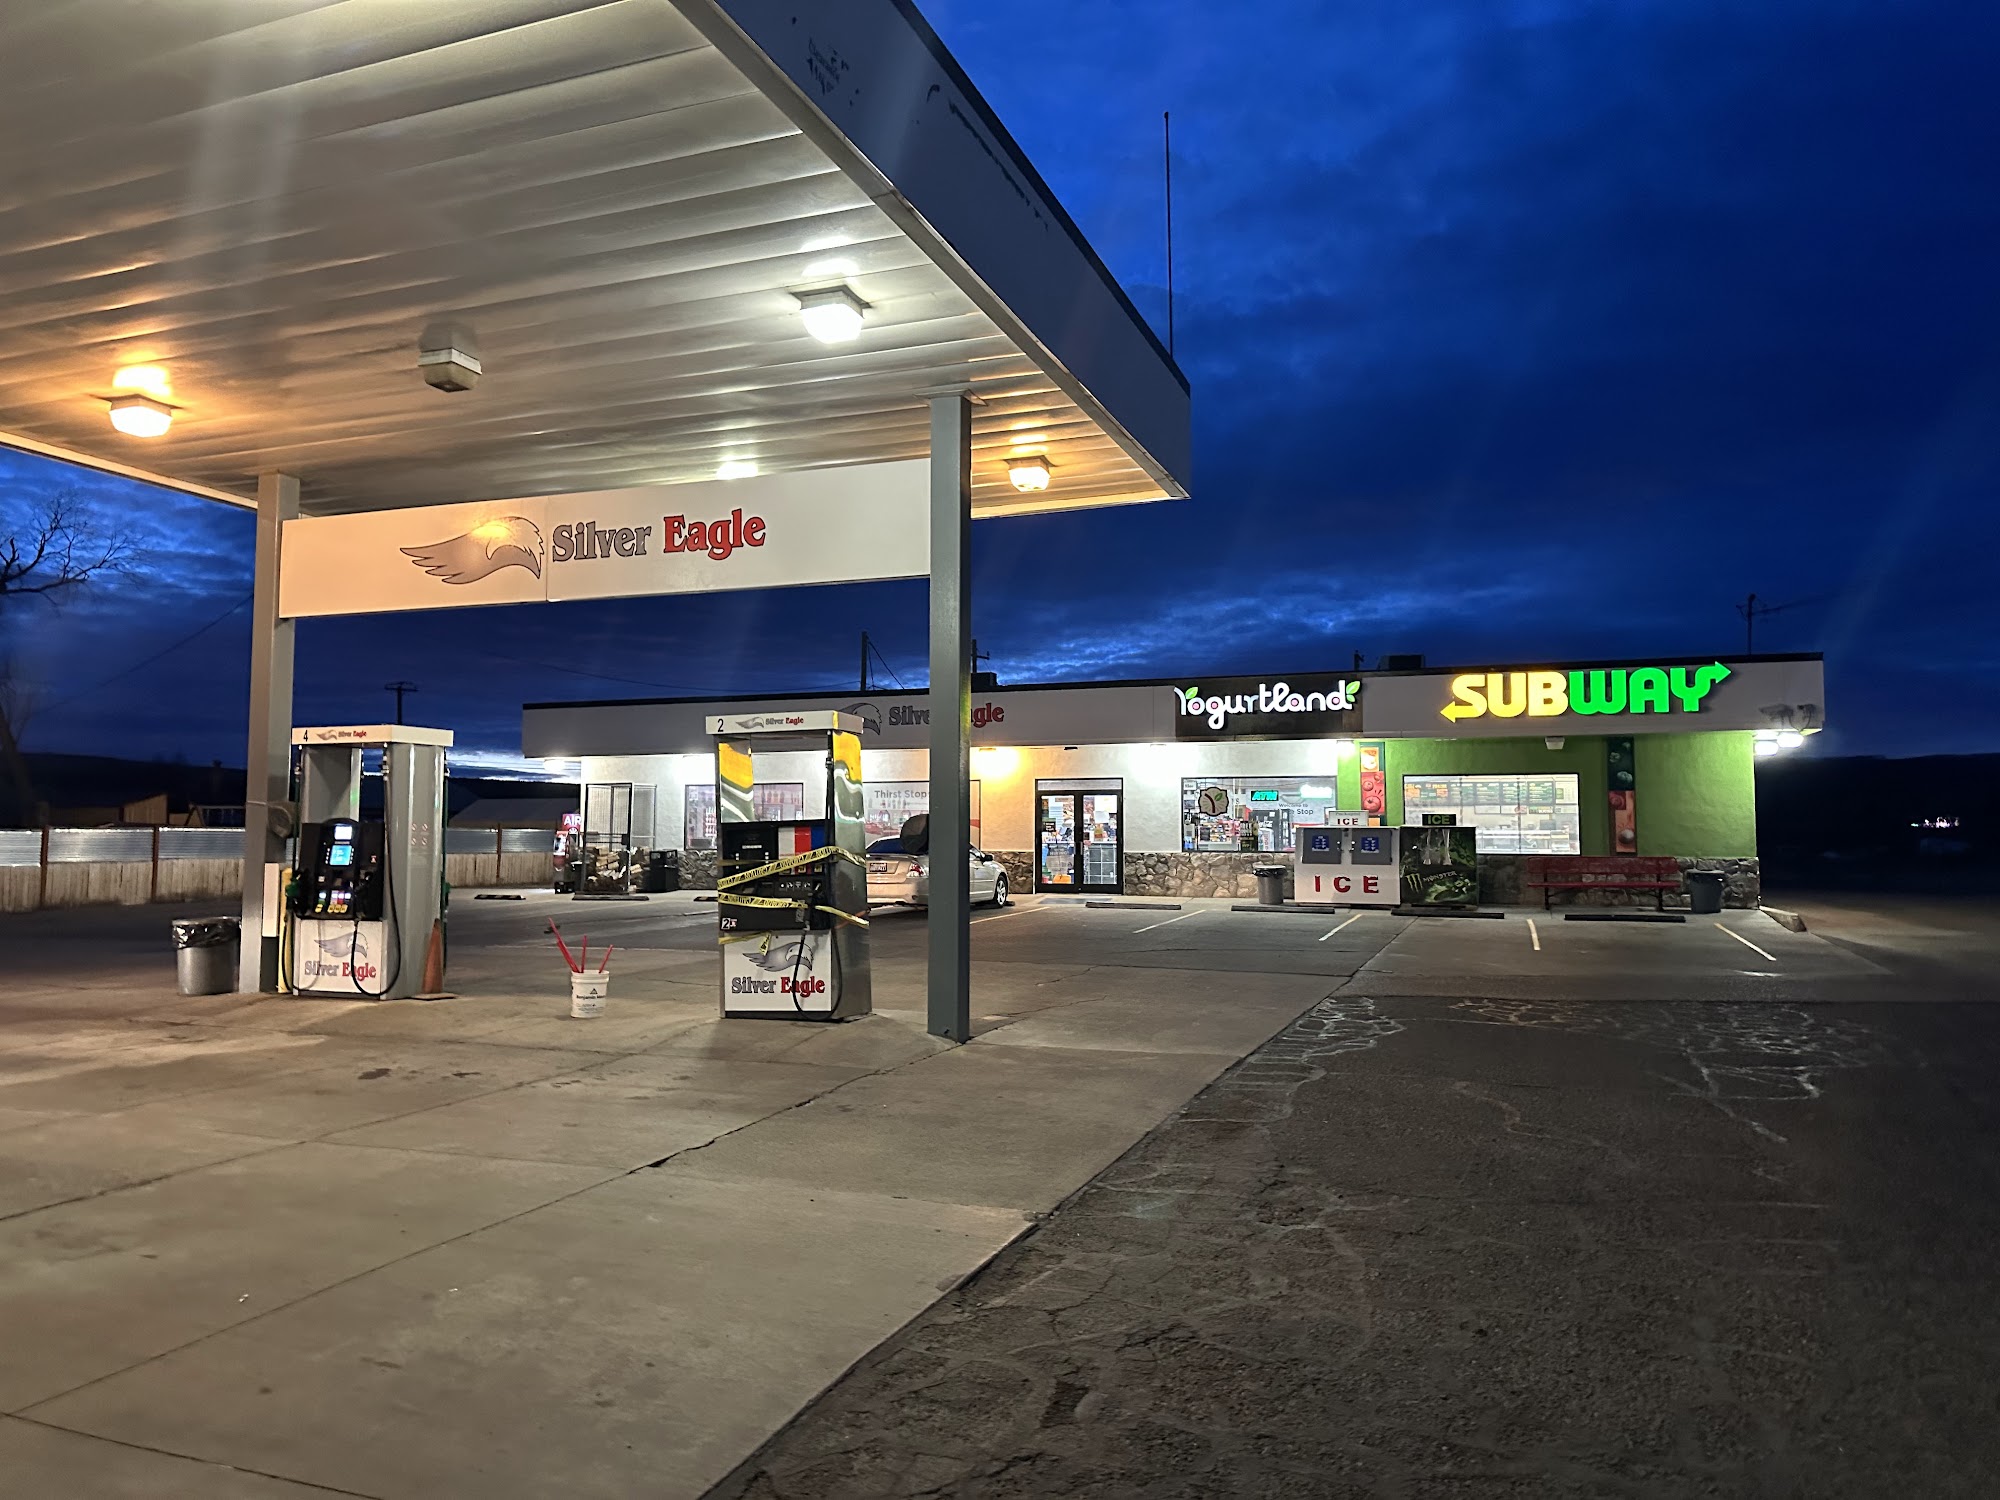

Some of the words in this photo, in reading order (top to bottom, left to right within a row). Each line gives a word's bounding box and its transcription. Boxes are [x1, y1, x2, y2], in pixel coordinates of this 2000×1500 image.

[552, 520, 652, 563] Silver
[663, 508, 766, 561] Eagle
[1440, 661, 1731, 723] SUBWAY
[1173, 680, 1353, 730] Yogurtland
[888, 705, 930, 726] Silve
[971, 702, 1005, 729] gle
[717, 718, 724, 732] 2
[765, 717, 785, 726] Silver
[785, 717, 804, 726] Eagle
[303, 729, 309, 743] 4
[353, 730, 367, 738] Eagle
[874, 790, 902, 799] Thirst
[904, 790, 927, 800] Stop
[1252, 791, 1278, 801] ATM
[1296, 808, 1314, 816] Stop
[563, 816, 582, 826] AIR
[1337, 818, 1359, 826] ICE
[1428, 814, 1450, 825] ICE
[1314, 875, 1379, 894] ICE
[723, 918, 730, 929] 2
[304, 960, 340, 977] Silver
[731, 976, 777, 994] Silver
